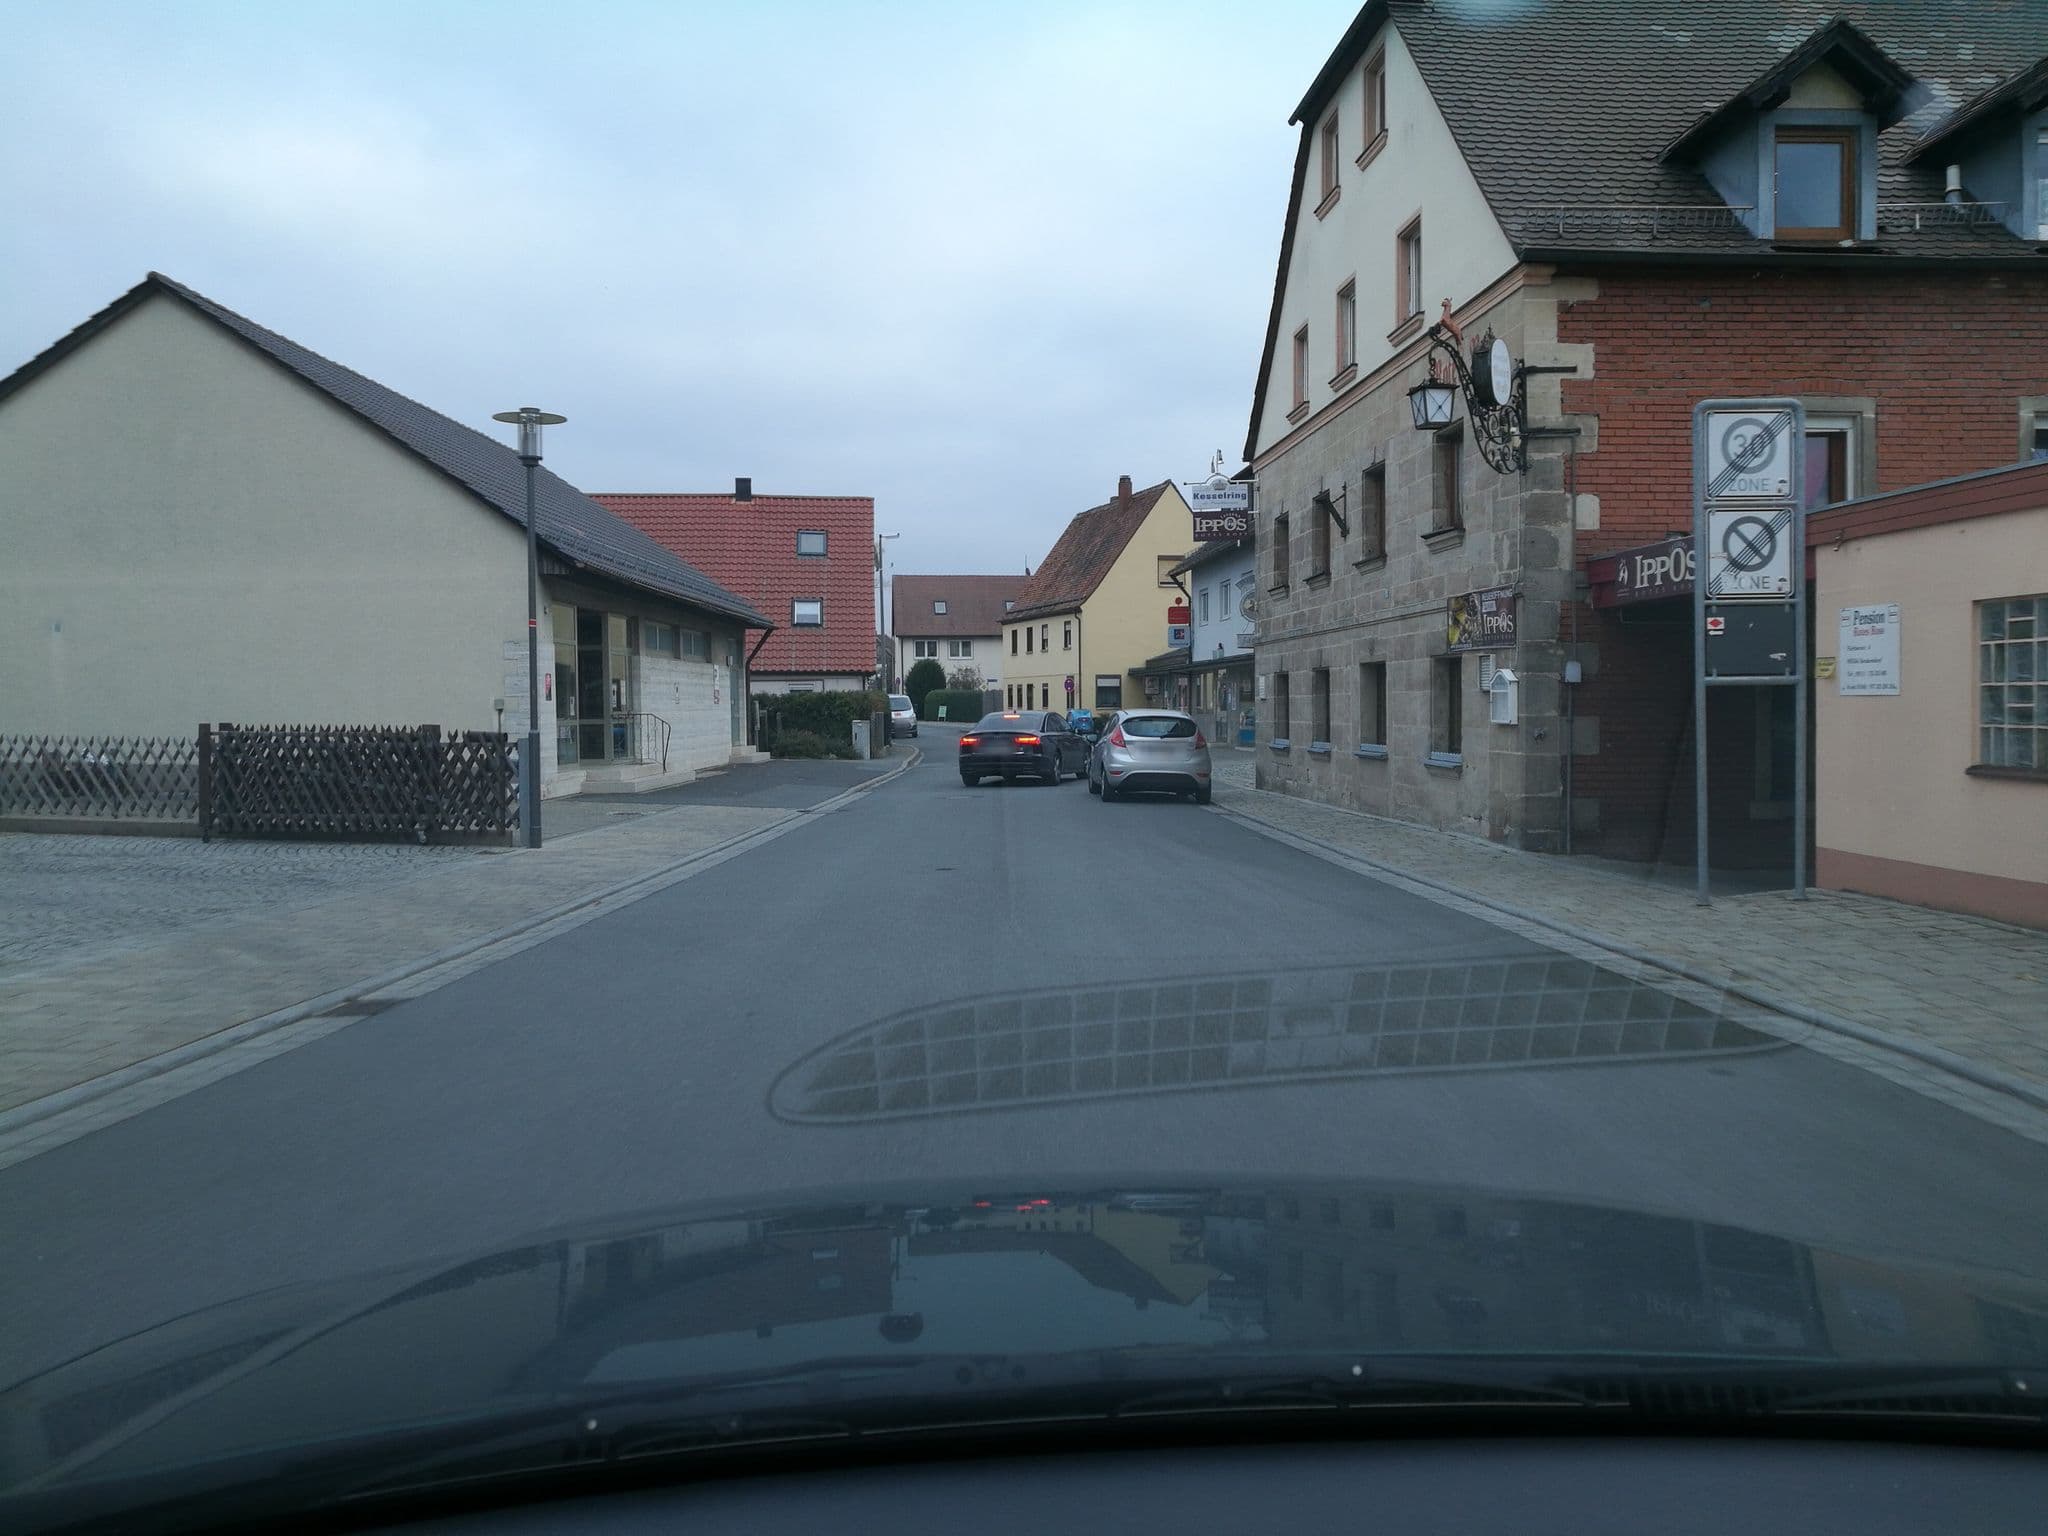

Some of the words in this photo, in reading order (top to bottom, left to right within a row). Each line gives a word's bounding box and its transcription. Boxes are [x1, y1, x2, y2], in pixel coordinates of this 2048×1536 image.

[1728, 478, 1770, 492] ZONE
[1193, 492, 1247, 500] Kesselring
[1853, 610, 1885, 625] Pension
